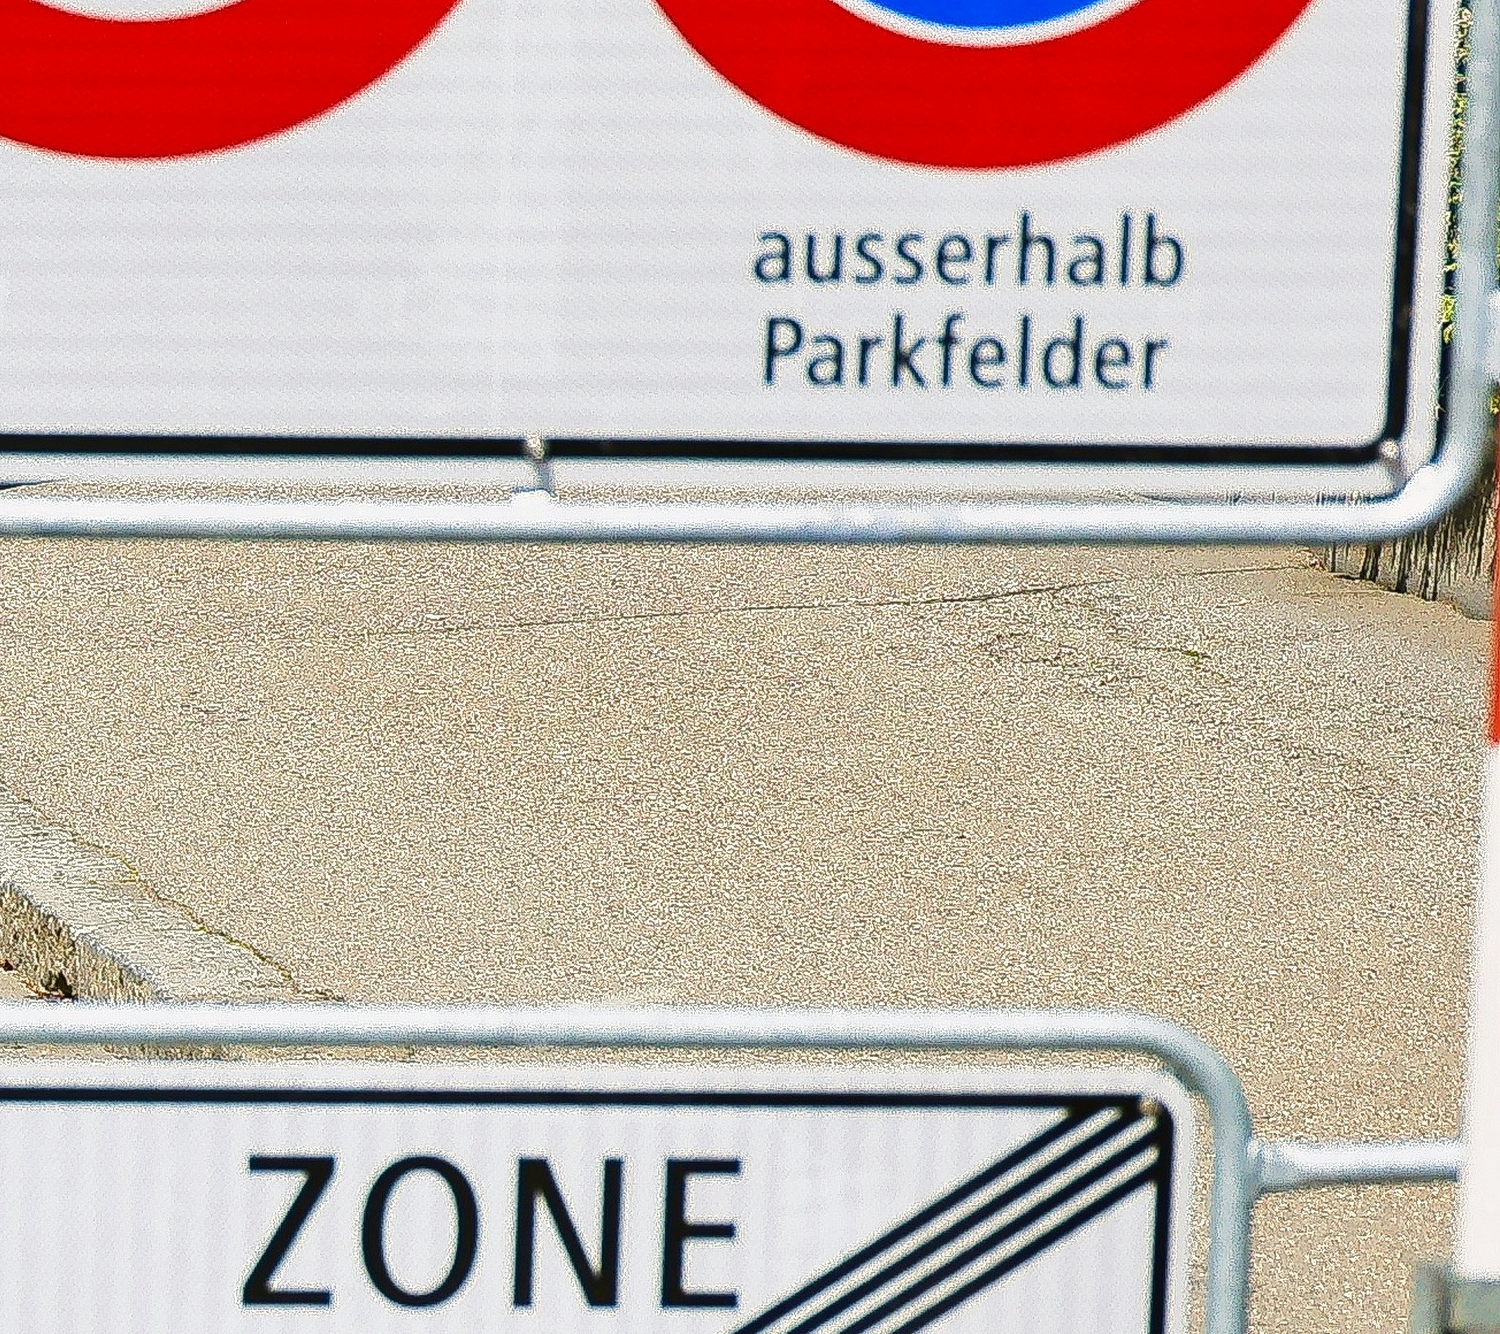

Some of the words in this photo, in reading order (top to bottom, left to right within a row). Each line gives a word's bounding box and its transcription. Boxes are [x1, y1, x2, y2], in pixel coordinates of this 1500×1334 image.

[754, 209, 1186, 288] ausserhalb
[764, 311, 1170, 390] Parkfelder
[241, 1153, 742, 1309] ZONE
